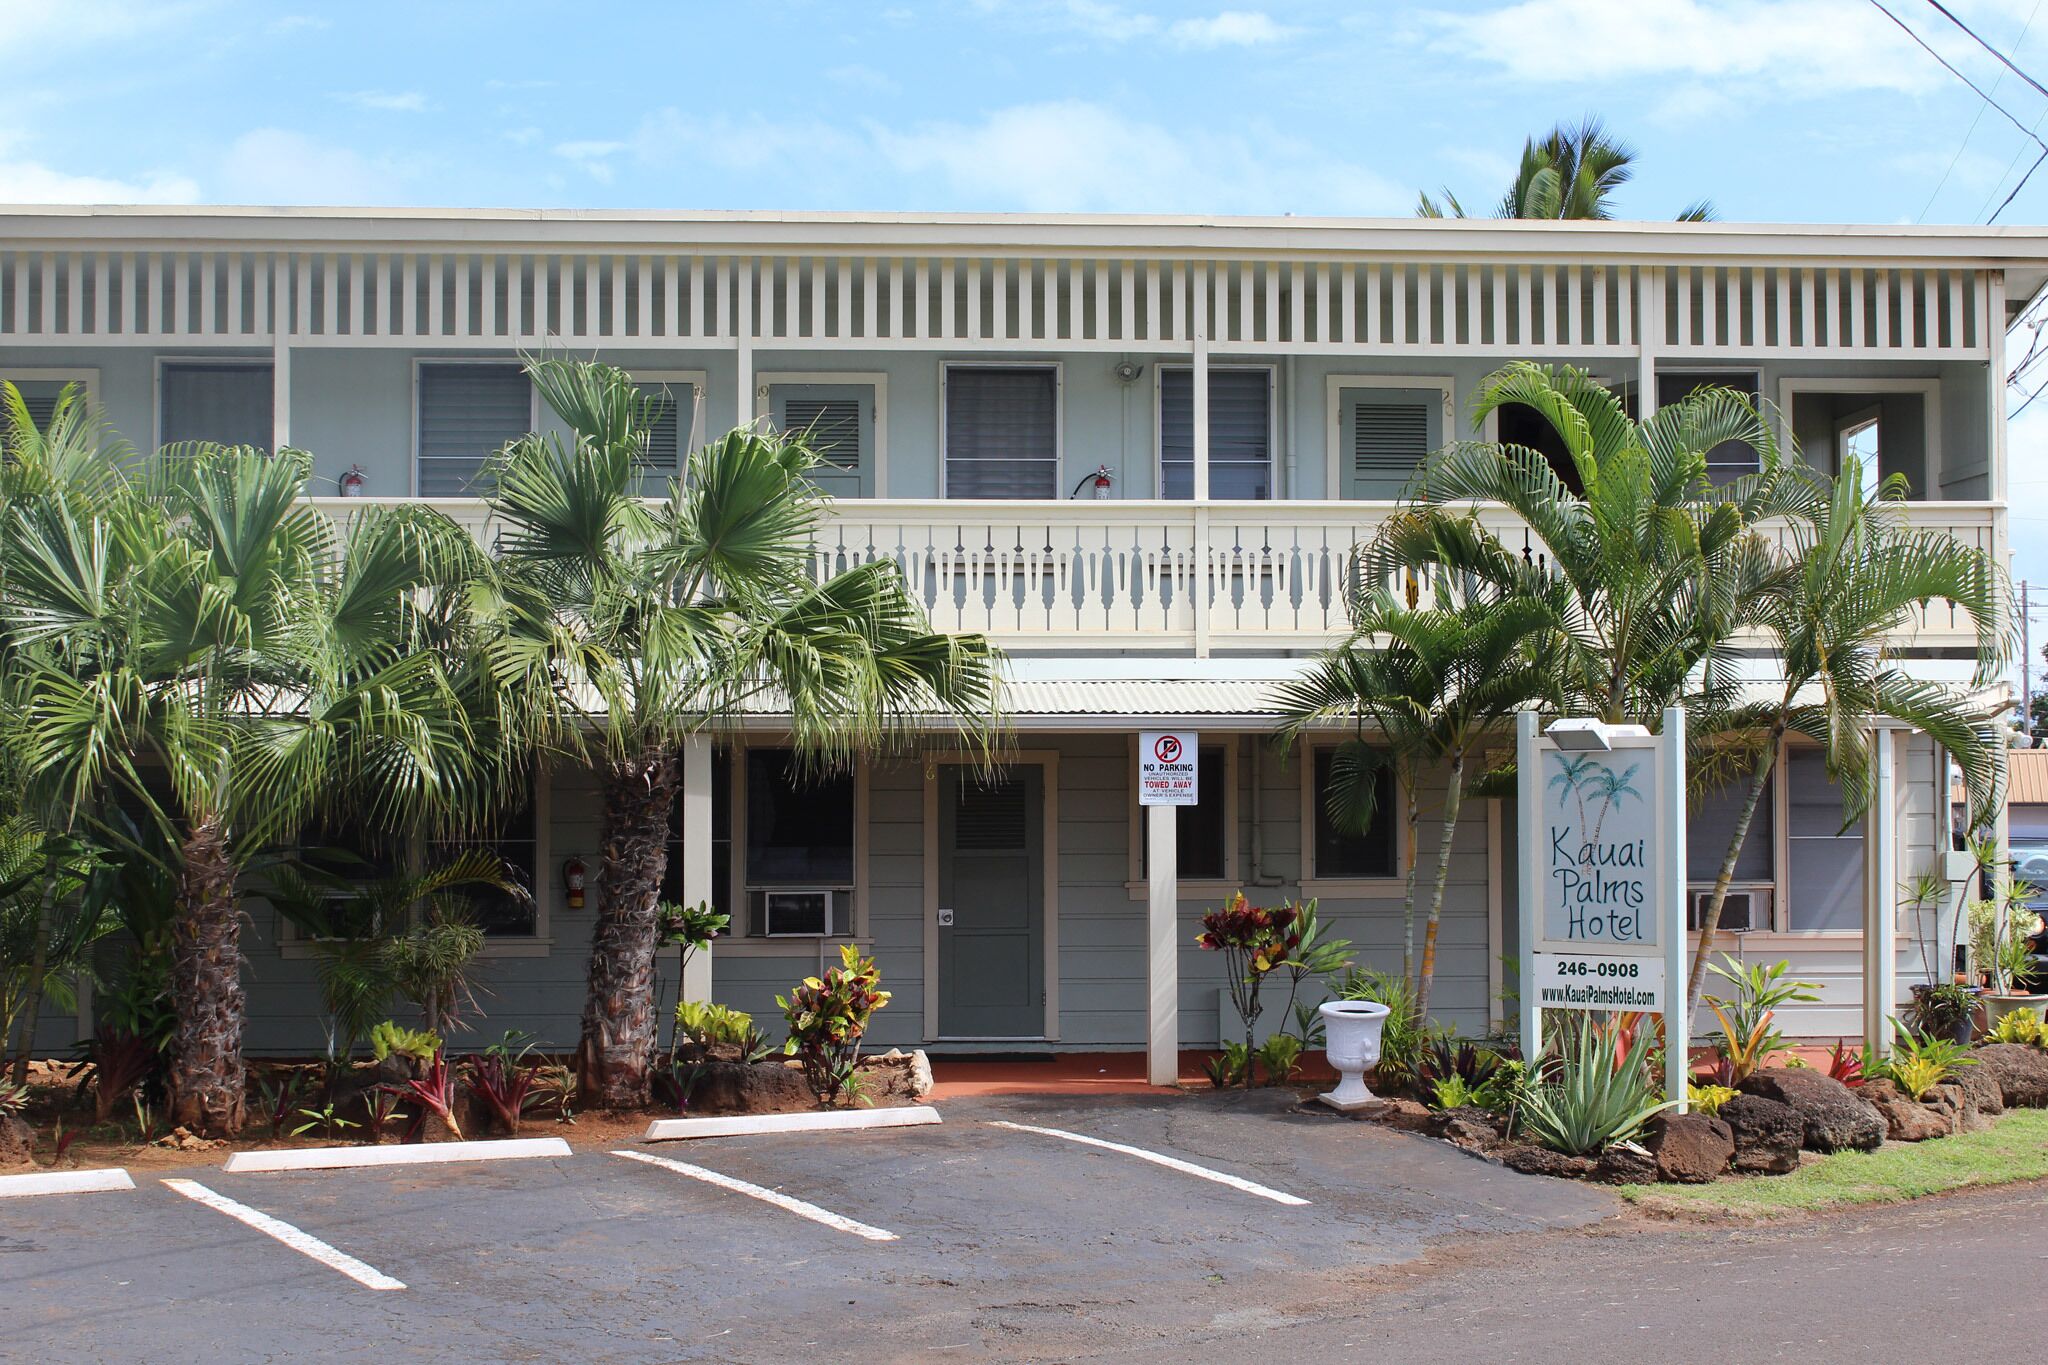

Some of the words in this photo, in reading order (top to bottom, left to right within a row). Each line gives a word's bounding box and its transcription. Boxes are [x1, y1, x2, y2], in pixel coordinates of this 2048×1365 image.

[1143, 764, 1155, 772] NO
[1159, 764, 1193, 772] PARKING
[1144, 781, 1169, 789] TOWED
[1173, 781, 1192, 789] AWAY
[1551, 826, 1644, 868] Kauai
[1552, 868, 1644, 908] Palms
[1568, 905, 1642, 941] Hotel
[1557, 961, 1639, 978] 246-0908
[1541, 984, 1655, 1006] www.KauaiPalmsHotel.com
